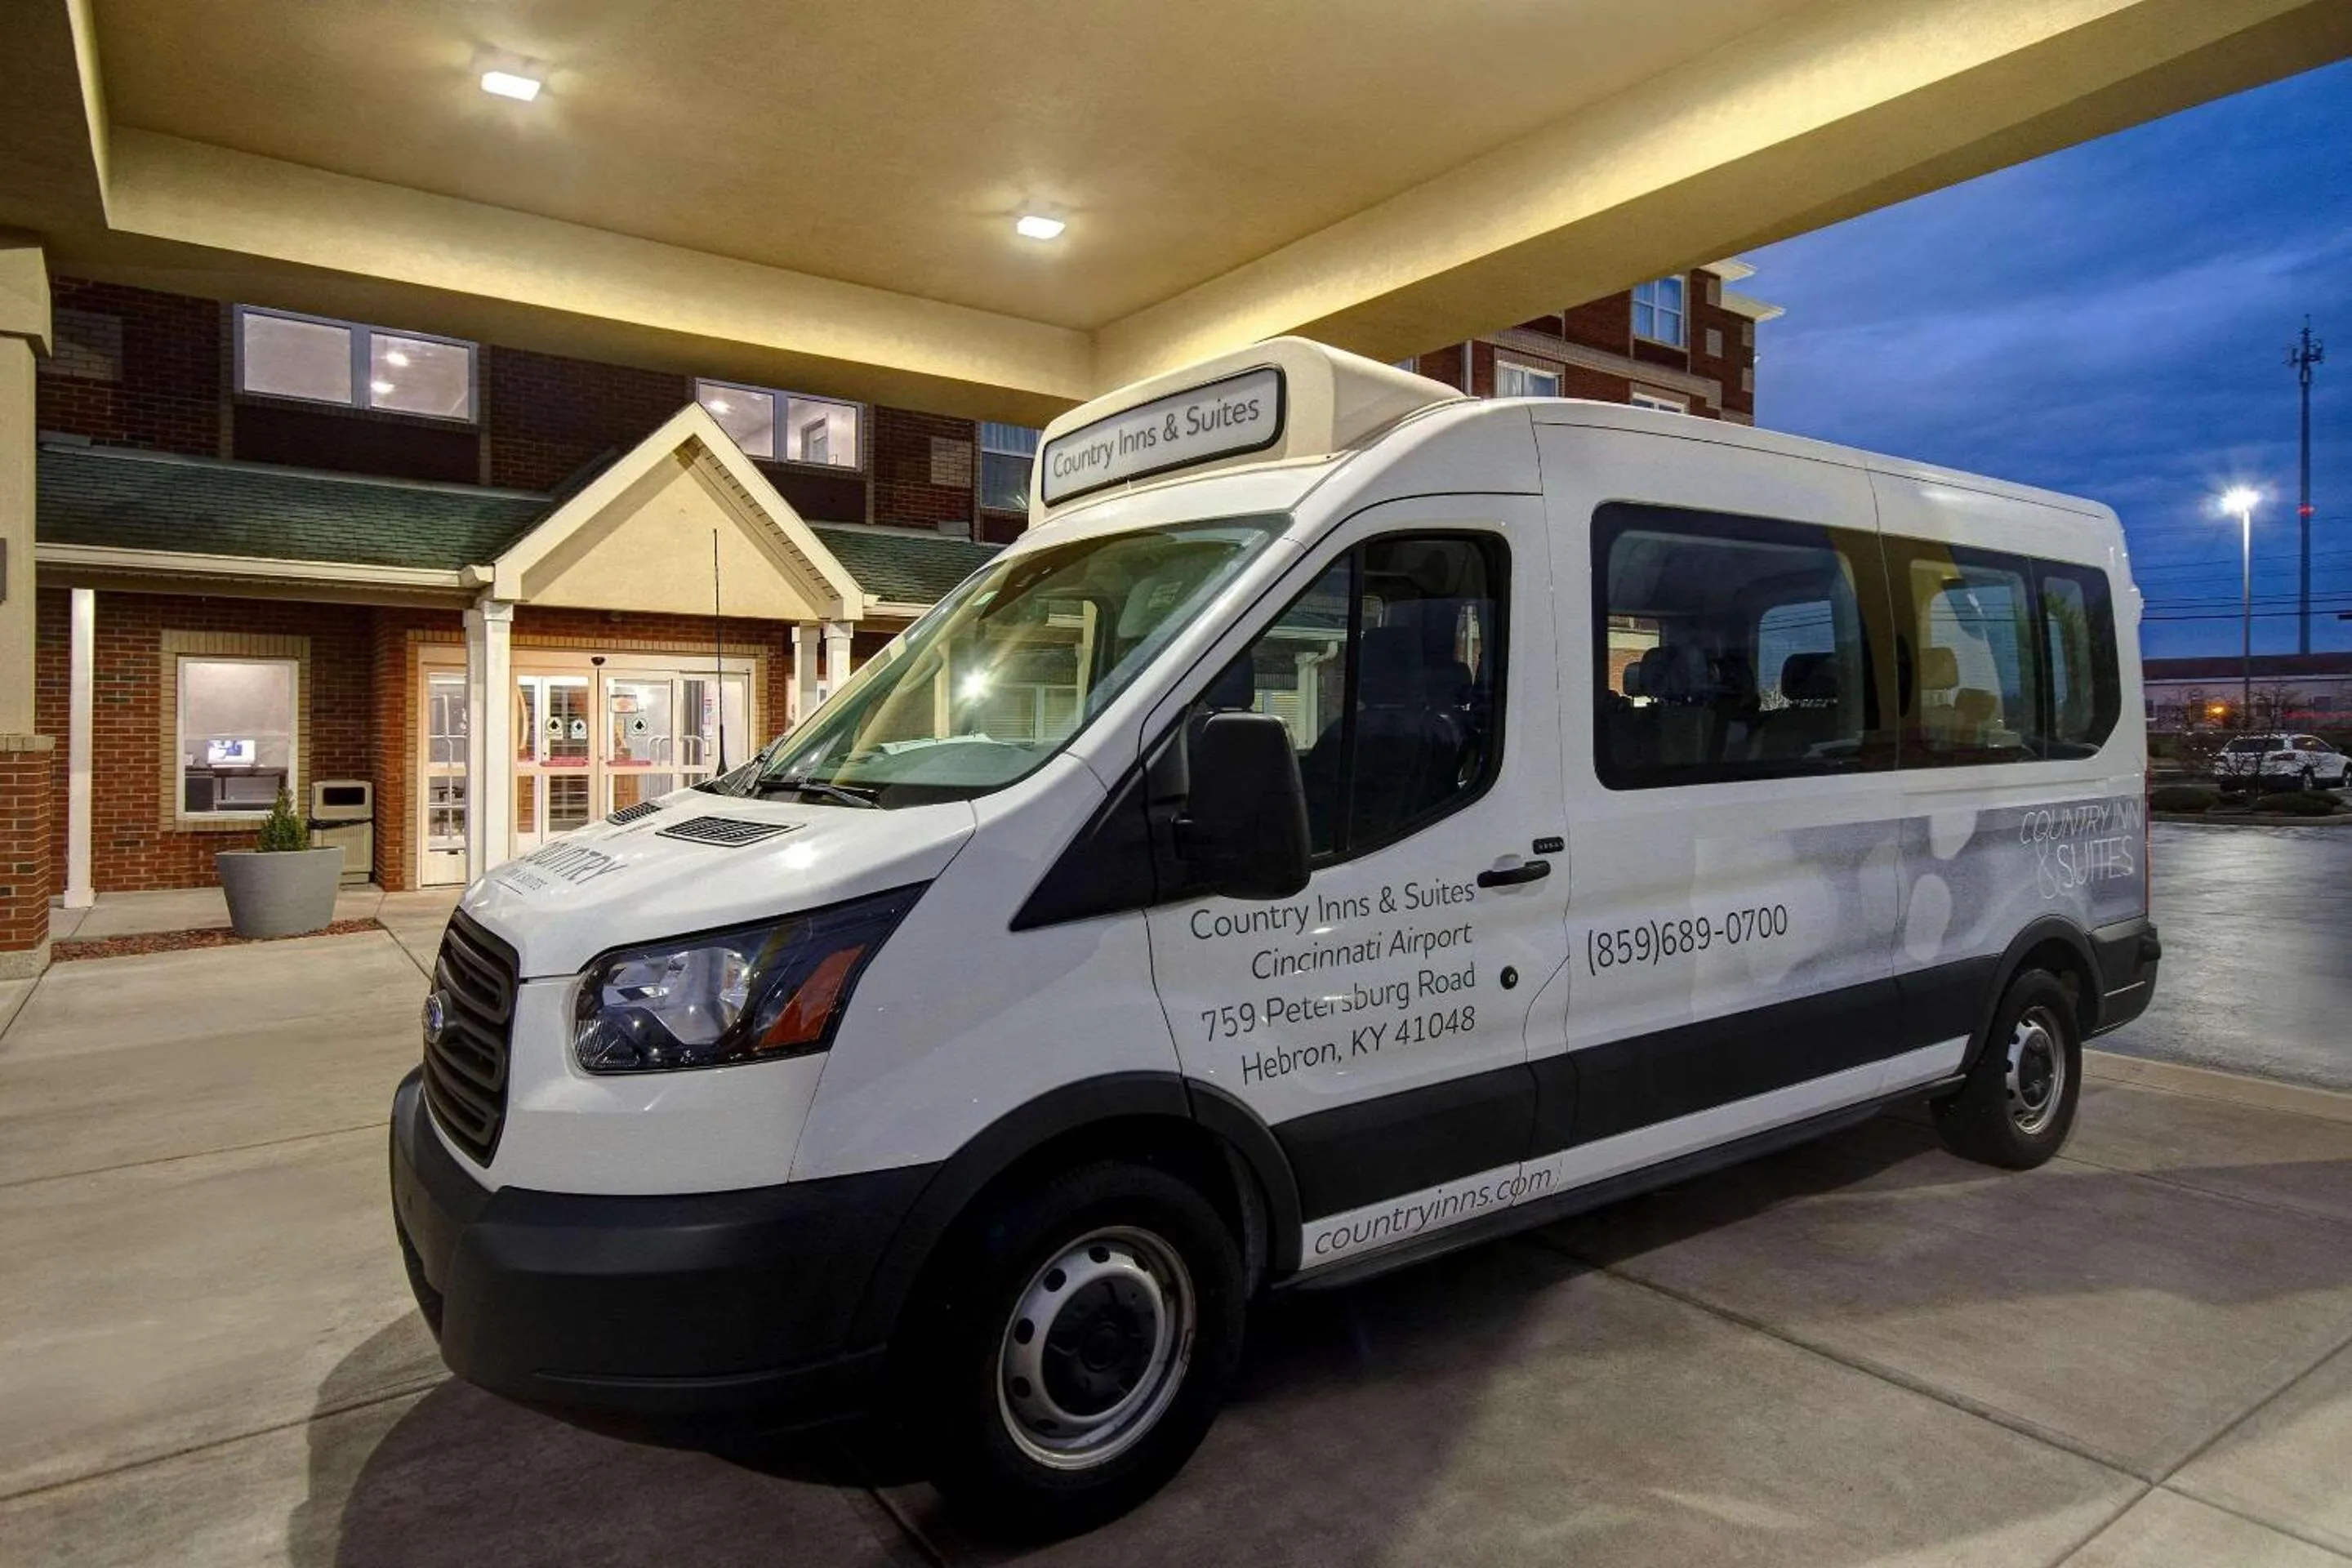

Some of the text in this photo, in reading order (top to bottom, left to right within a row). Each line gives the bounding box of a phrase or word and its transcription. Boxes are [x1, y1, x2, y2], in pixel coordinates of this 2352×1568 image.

[1054, 399, 1260, 478] Country Inns & Suites
[2020, 804, 2110, 844] COUNTRY
[2056, 835, 2133, 888] SUITES
[1191, 879, 1475, 940] Country Inns & Suites
[1588, 904, 1787, 976] (859)689-0700
[1252, 923, 1474, 979] Cincinnati Airport
[1201, 962, 1476, 1042] 759 Petersburg Road
[1241, 1005, 1476, 1085] Hebron, KY 41048
[1315, 1168, 1551, 1254] countryinns.com
